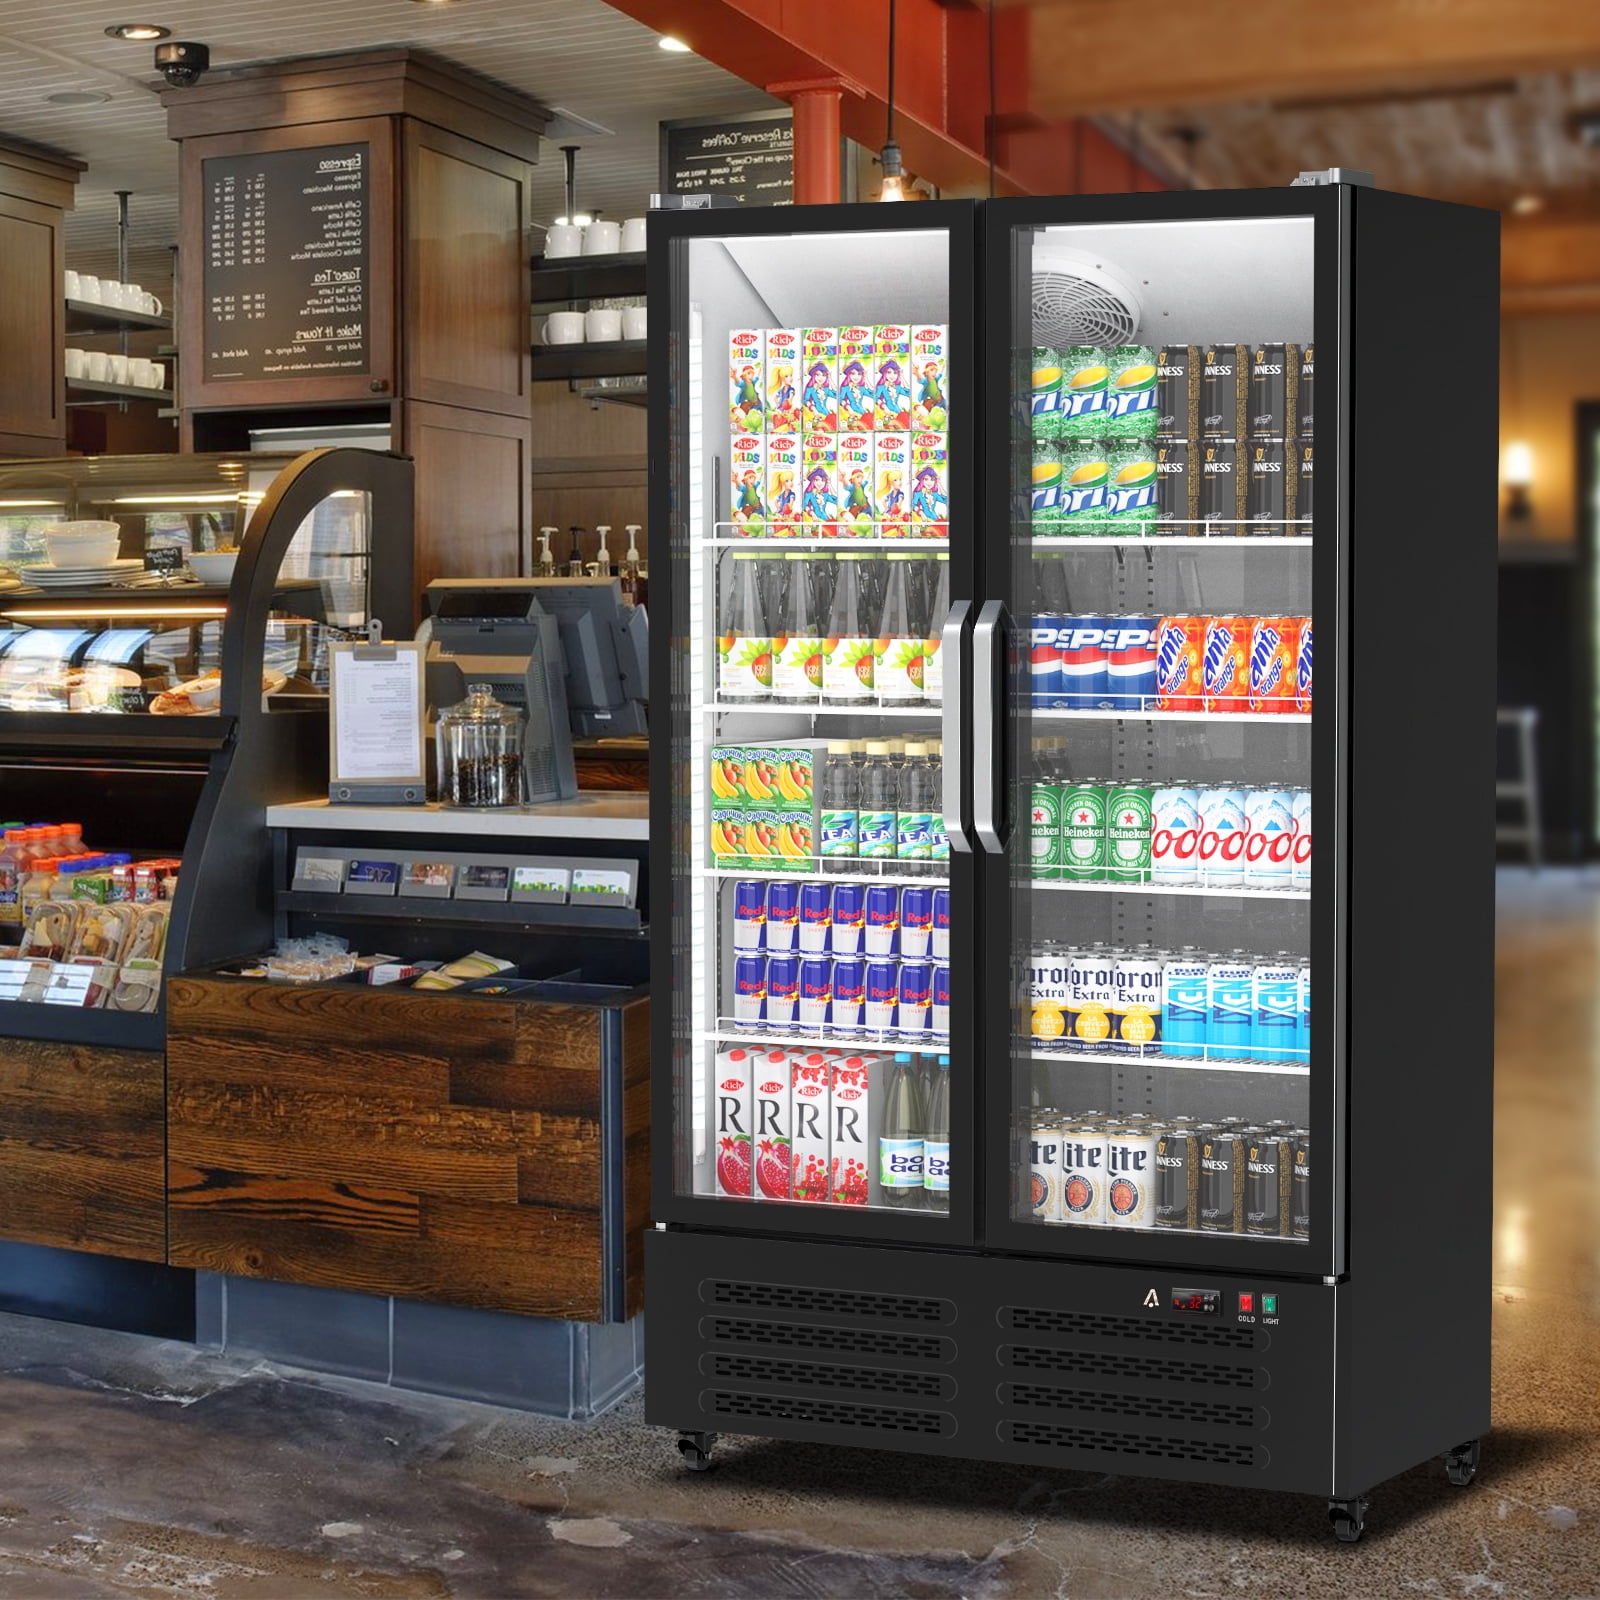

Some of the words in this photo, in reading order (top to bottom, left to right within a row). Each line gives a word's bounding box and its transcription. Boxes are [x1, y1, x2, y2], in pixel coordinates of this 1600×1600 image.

[1167, 656, 1189, 694] orange
[1213, 657, 1235, 694] orange
[1260, 658, 1282, 696] orange
[1064, 827, 1105, 837] Heineken
[1110, 828, 1150, 839] Heineken
[1073, 987, 1109, 1000] Extra
[1119, 990, 1155, 1002] Extra
[719, 1097, 746, 1133] R
[758, 1099, 784, 1136] R
[797, 1103, 823, 1139] R
[836, 1106, 863, 1143] R
[1238, 1315, 1256, 1323] COLD
[1262, 1317, 1280, 1325] LIGHT
